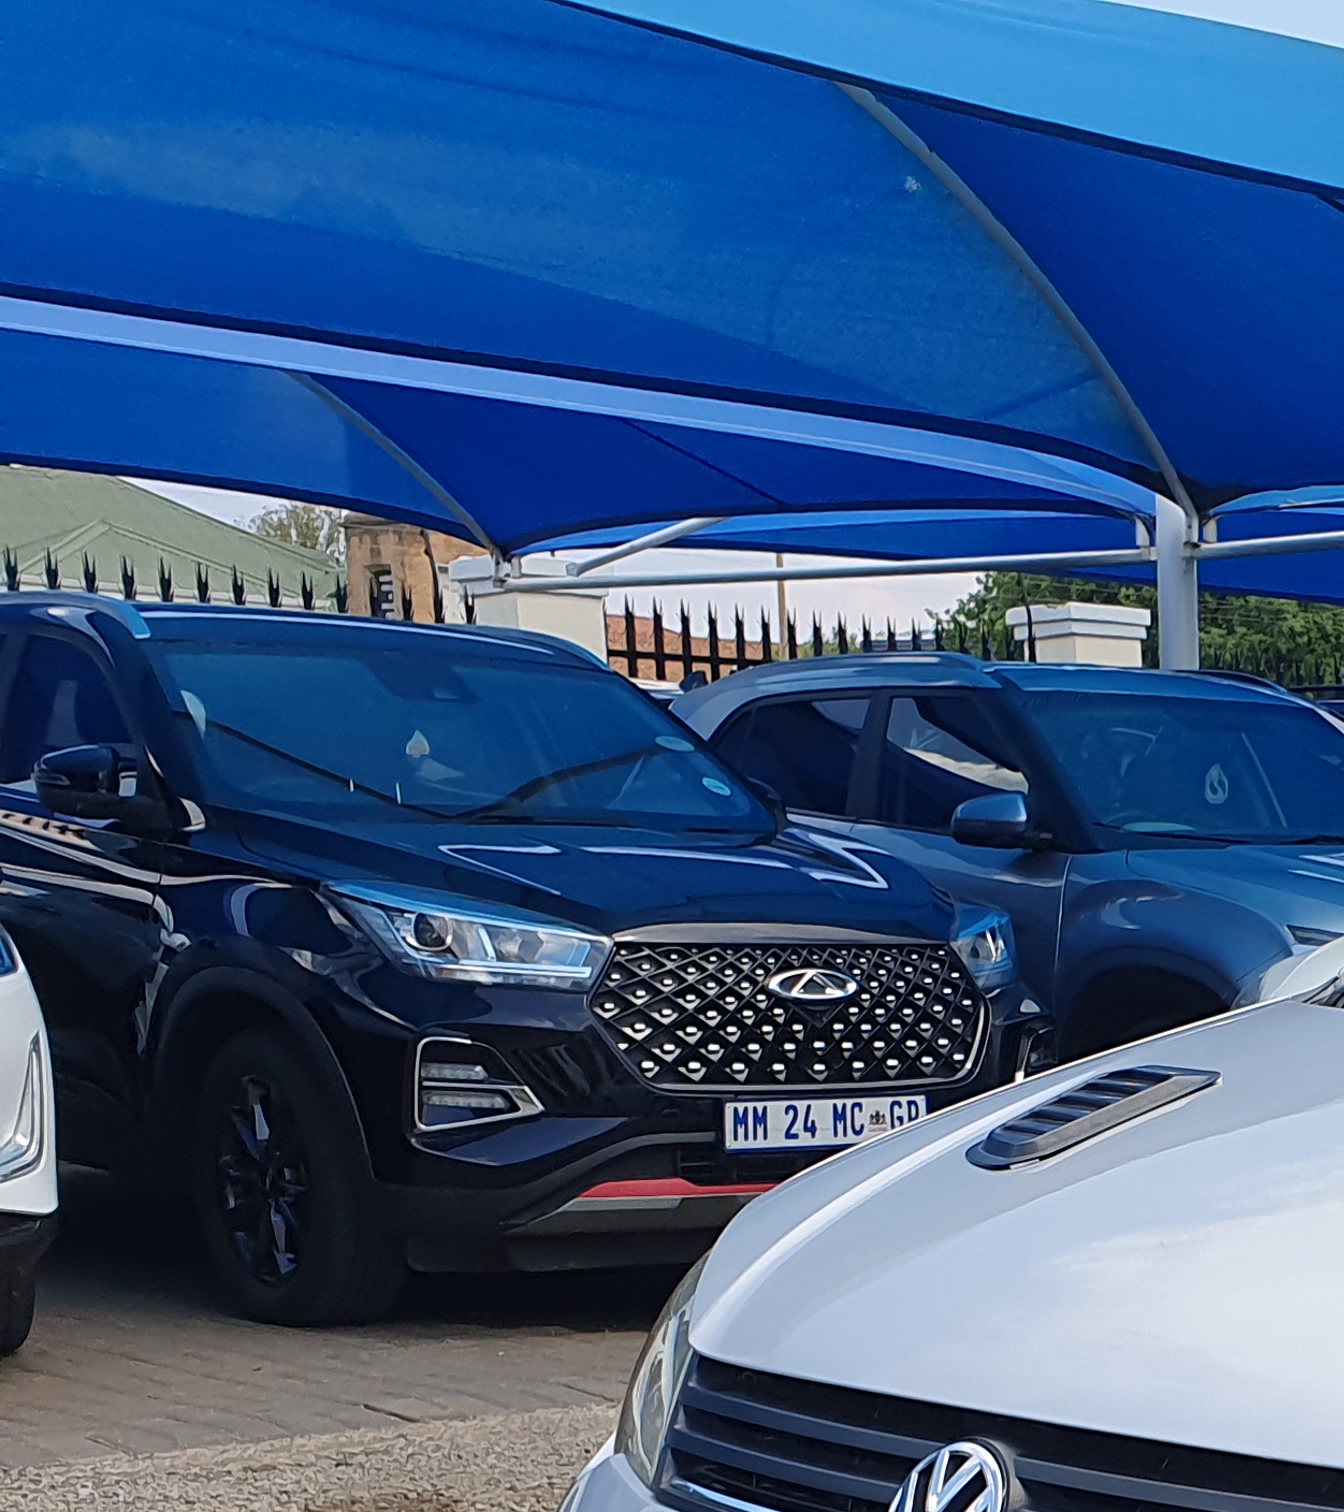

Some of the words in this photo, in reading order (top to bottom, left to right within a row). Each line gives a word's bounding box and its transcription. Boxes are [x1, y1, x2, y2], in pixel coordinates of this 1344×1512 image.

[732, 1105, 768, 1142] MM
[784, 1103, 818, 1140] 24
[832, 1101, 865, 1138] MC
